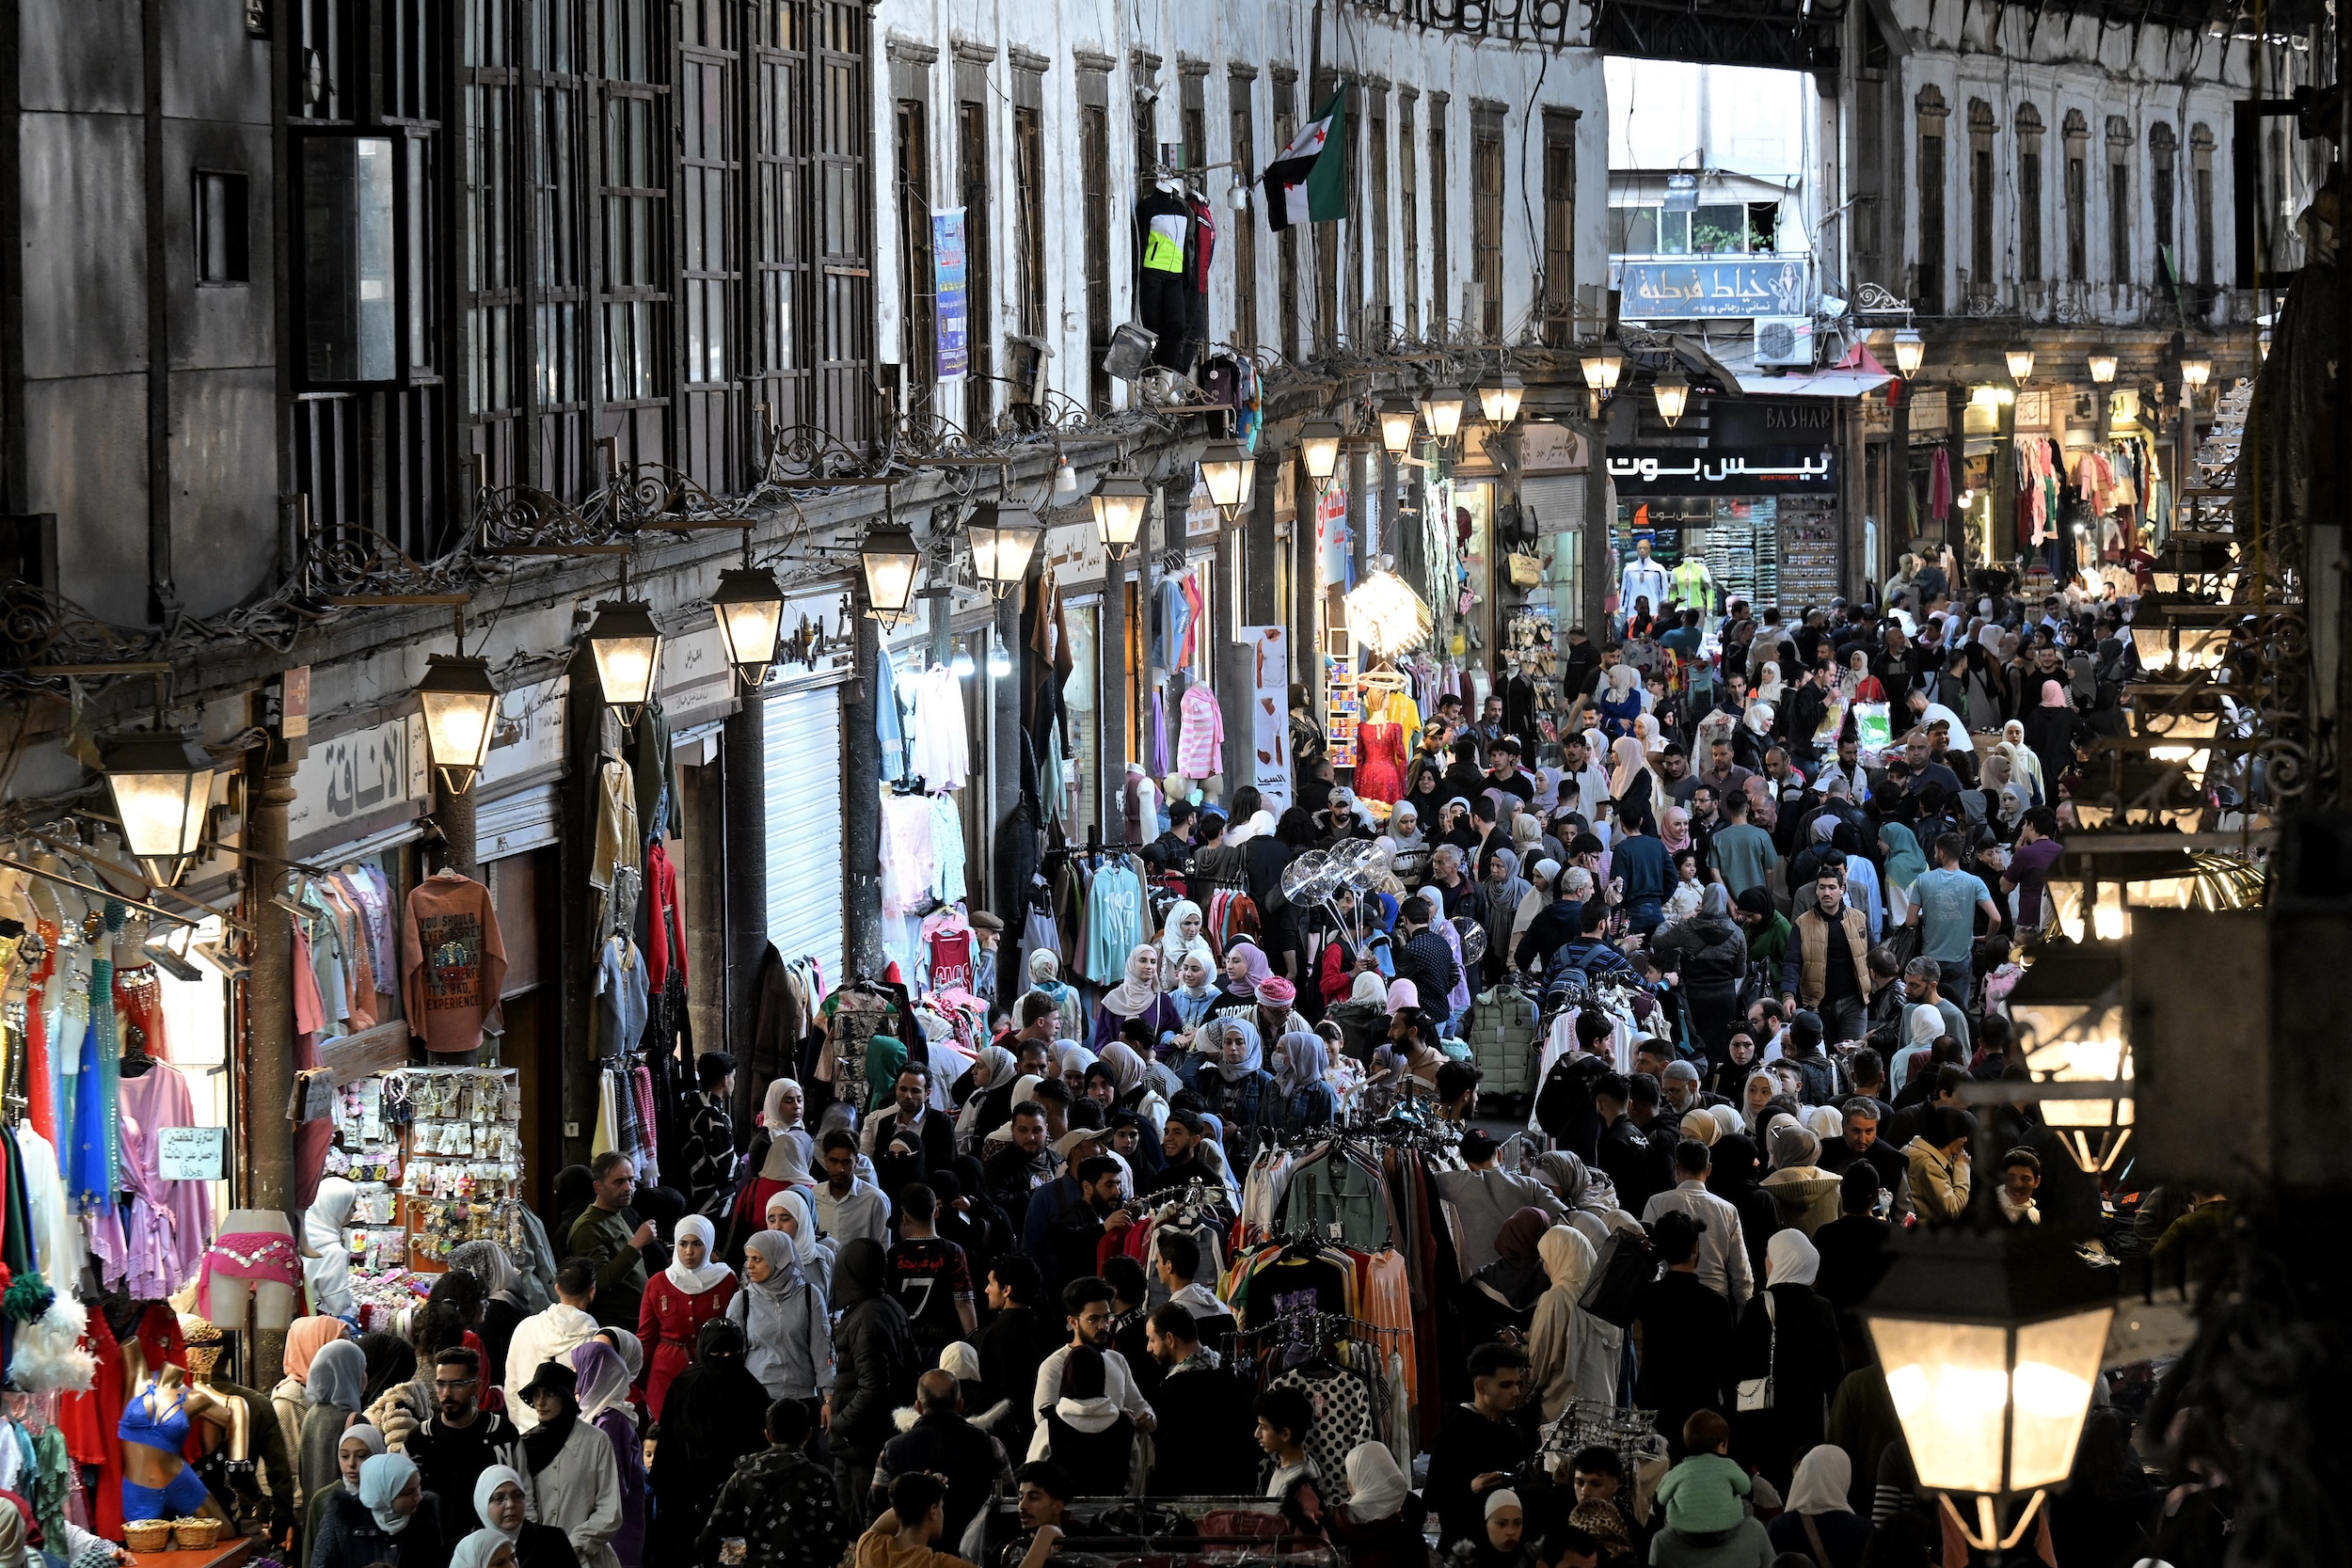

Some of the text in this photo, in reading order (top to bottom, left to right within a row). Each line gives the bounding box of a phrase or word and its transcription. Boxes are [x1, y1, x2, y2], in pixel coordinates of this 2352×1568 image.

[1639, 267, 1770, 309] خياط قرطبة
[1606, 455, 1828, 482] بيس بوت
[442, 912, 475, 927] SHOULD
[900, 1276, 936, 1321] 7
